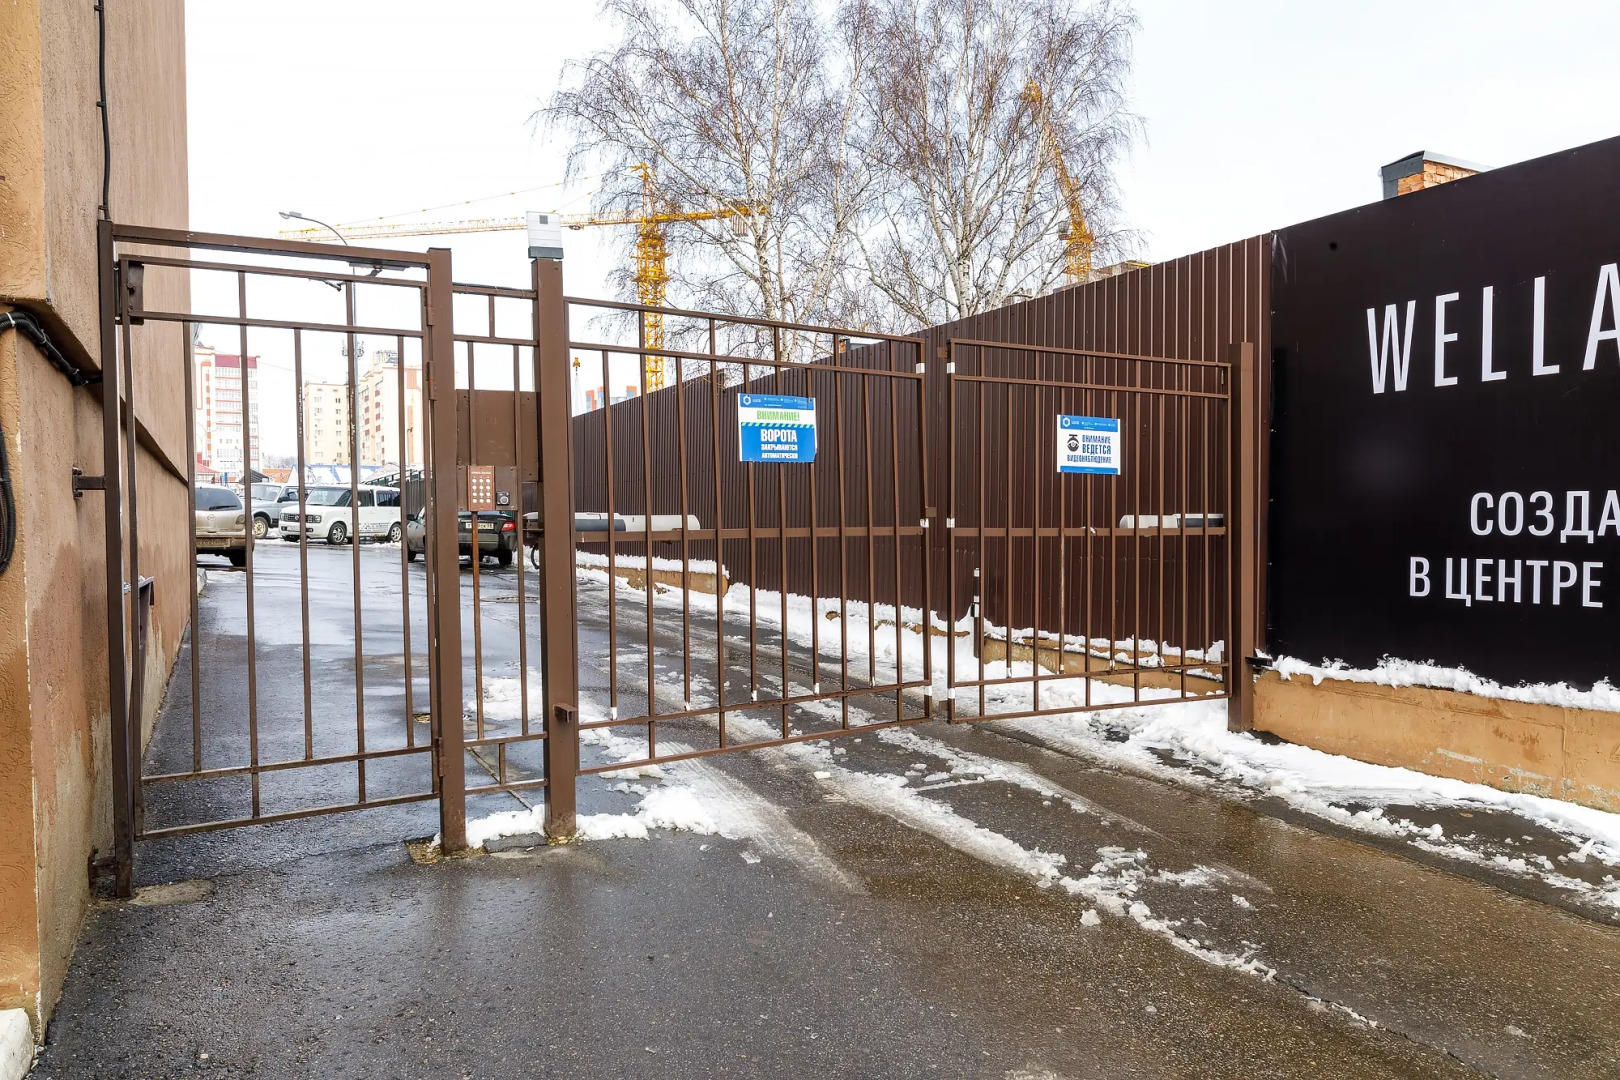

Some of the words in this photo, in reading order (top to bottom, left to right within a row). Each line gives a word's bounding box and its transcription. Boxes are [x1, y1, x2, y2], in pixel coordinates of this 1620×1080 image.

[760, 429, 798, 442] ВОРОТА
[1082, 434, 1111, 444] ВНИМАНИЕ
[1082, 443, 1112, 455] ВЕДЕТСЯ
[1470, 489, 1620, 544] СОЗДА
[1409, 556, 1431, 597] В
[1445, 557, 1604, 608] ЦЕНТРЕ
